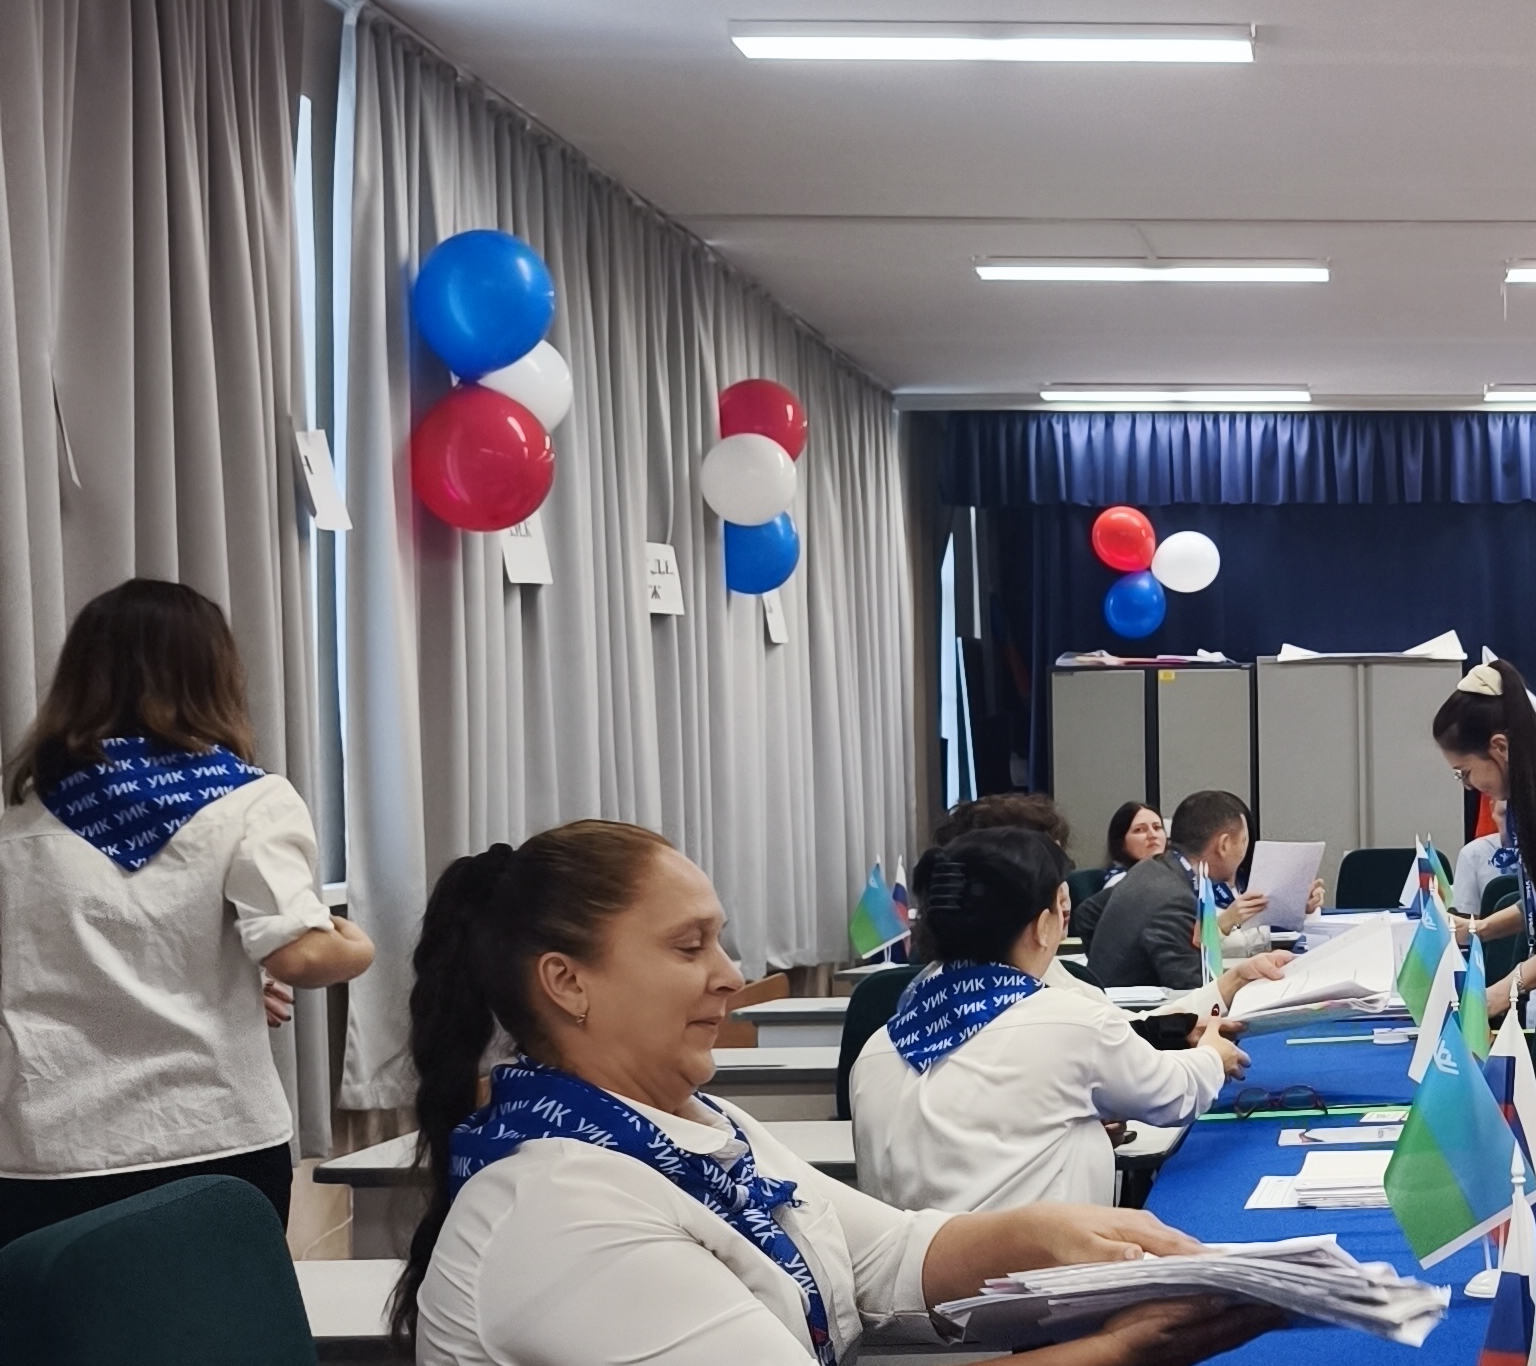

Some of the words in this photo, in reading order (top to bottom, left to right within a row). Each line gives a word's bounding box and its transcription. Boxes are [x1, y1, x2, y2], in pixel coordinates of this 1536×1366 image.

[66, 792, 99, 815] УИК
[102, 780, 141, 800] УИК
[146, 770, 186, 789] УИК
[191, 764, 230, 778] УИК
[75, 818, 112, 837] УИК
[113, 801, 149, 825] УИК
[153, 792, 193, 809] УИК
[198, 785, 234, 799] УИК
[125, 827, 159, 851] УИК
[922, 988, 948, 1013] УИК
[953, 977, 986, 995] УИК
[992, 975, 1027, 988] УИК
[893, 1030, 920, 1048] УИК
[925, 1013, 952, 1037] УИК
[953, 999, 987, 1019] УИК
[993, 991, 1026, 1008] УИК
[571, 1117, 618, 1148] УИК
[647, 1135, 686, 1176] УИК
[701, 1159, 735, 1199] УИК
[784, 1253, 818, 1296] УИК
